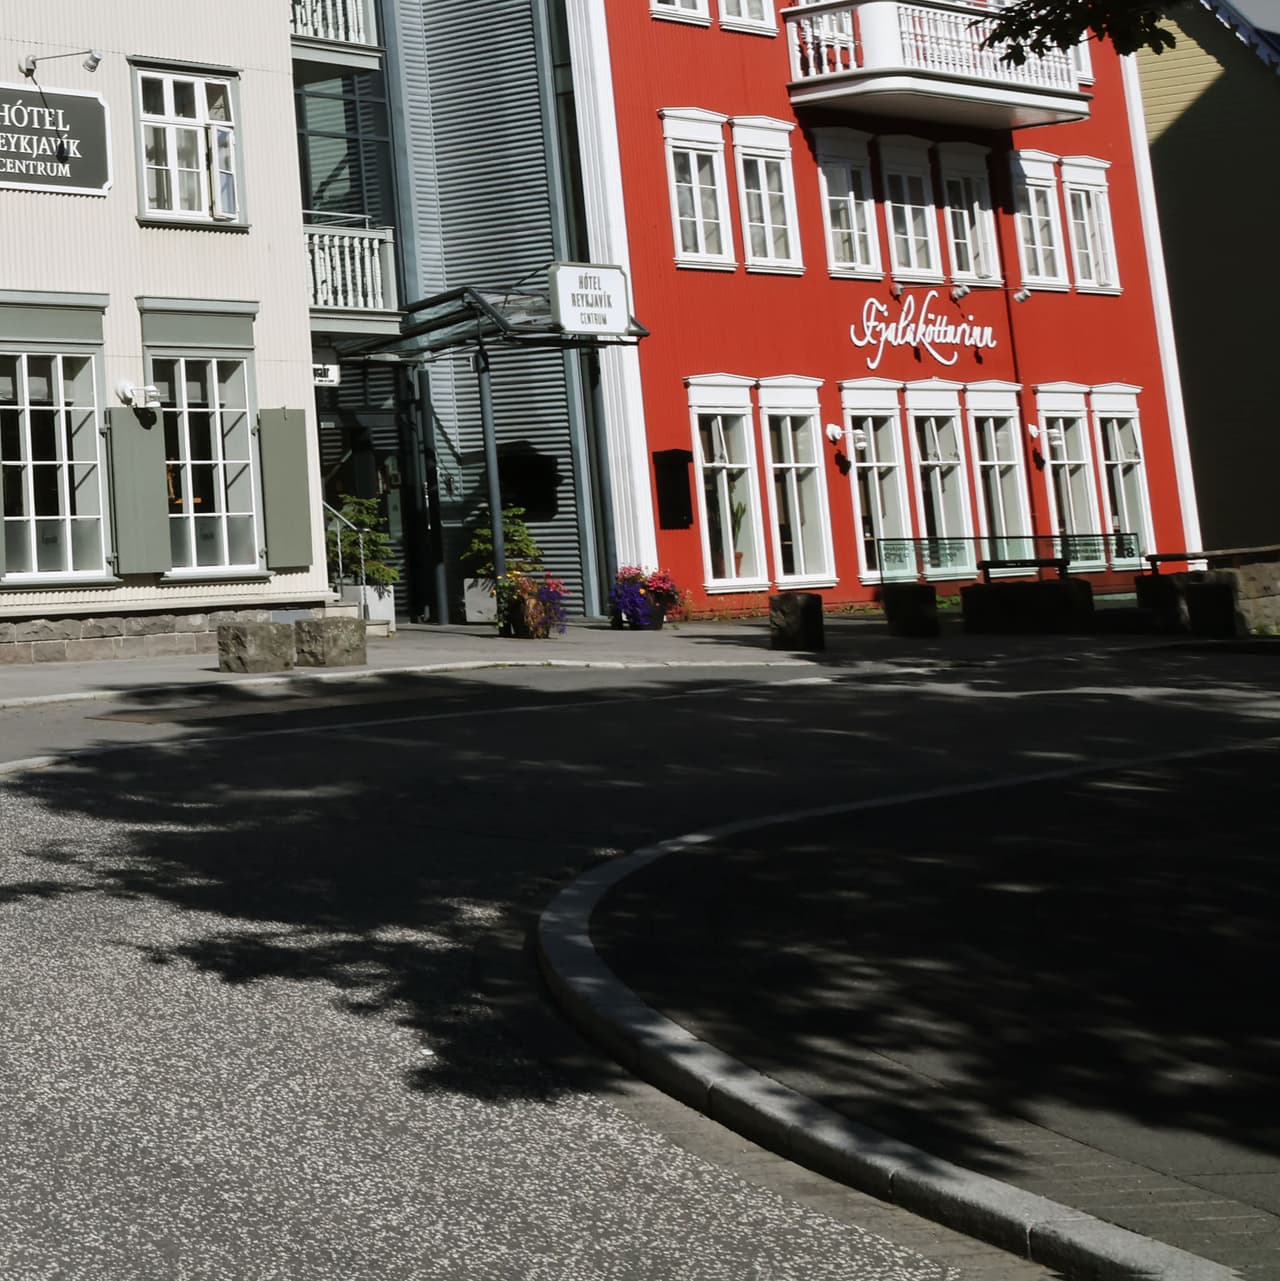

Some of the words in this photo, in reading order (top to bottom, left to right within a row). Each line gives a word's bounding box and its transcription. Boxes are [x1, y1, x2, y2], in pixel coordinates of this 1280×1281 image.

[578, 272, 601, 291] HÓTEL
[571, 291, 613, 308] REYKJAVÍK
[580, 312, 607, 325] CENTRUM
